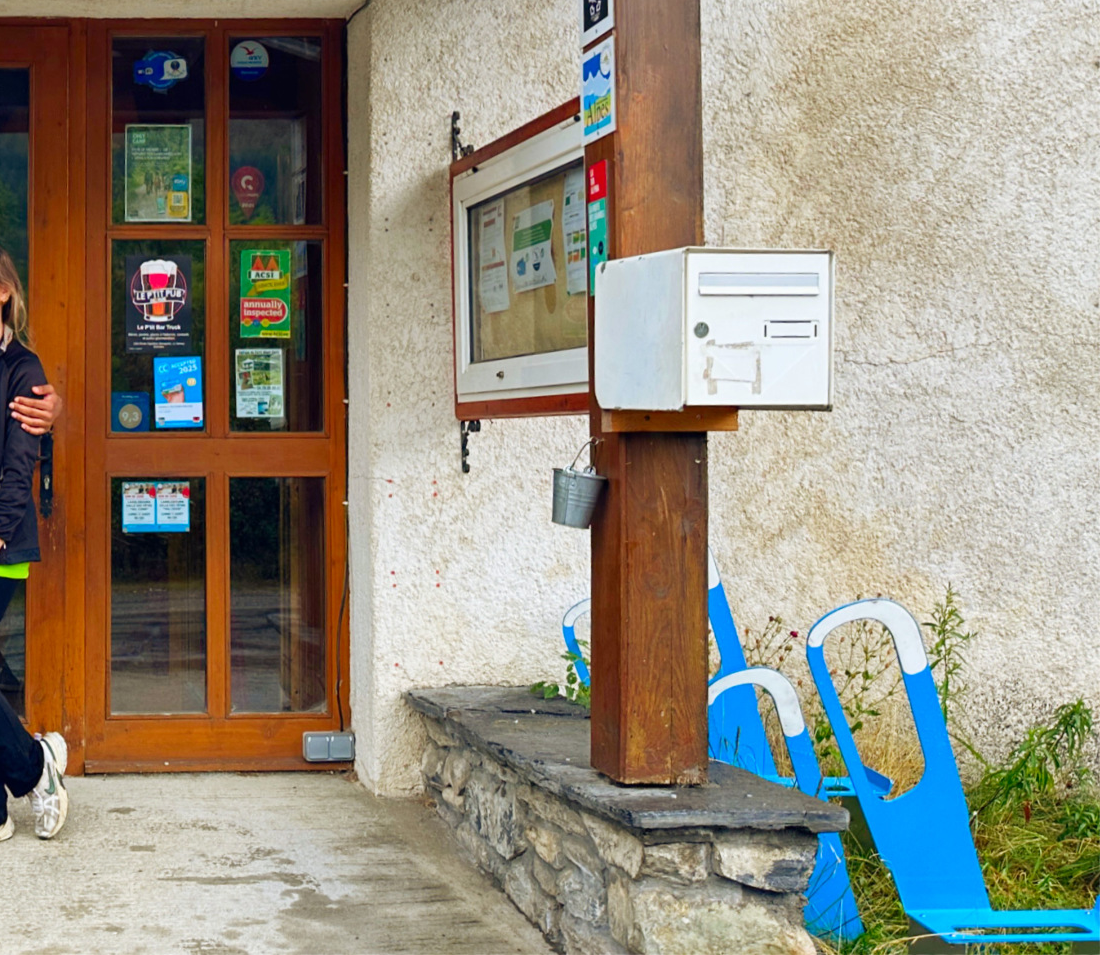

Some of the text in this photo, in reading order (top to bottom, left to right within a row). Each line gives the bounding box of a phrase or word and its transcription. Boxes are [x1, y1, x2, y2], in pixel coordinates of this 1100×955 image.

[135, 291, 146, 301] LE
[165, 289, 183, 299] PUB
[243, 300, 283, 310] annually
[243, 308, 283, 318] inspected
[121, 411, 140, 423] 9,3
